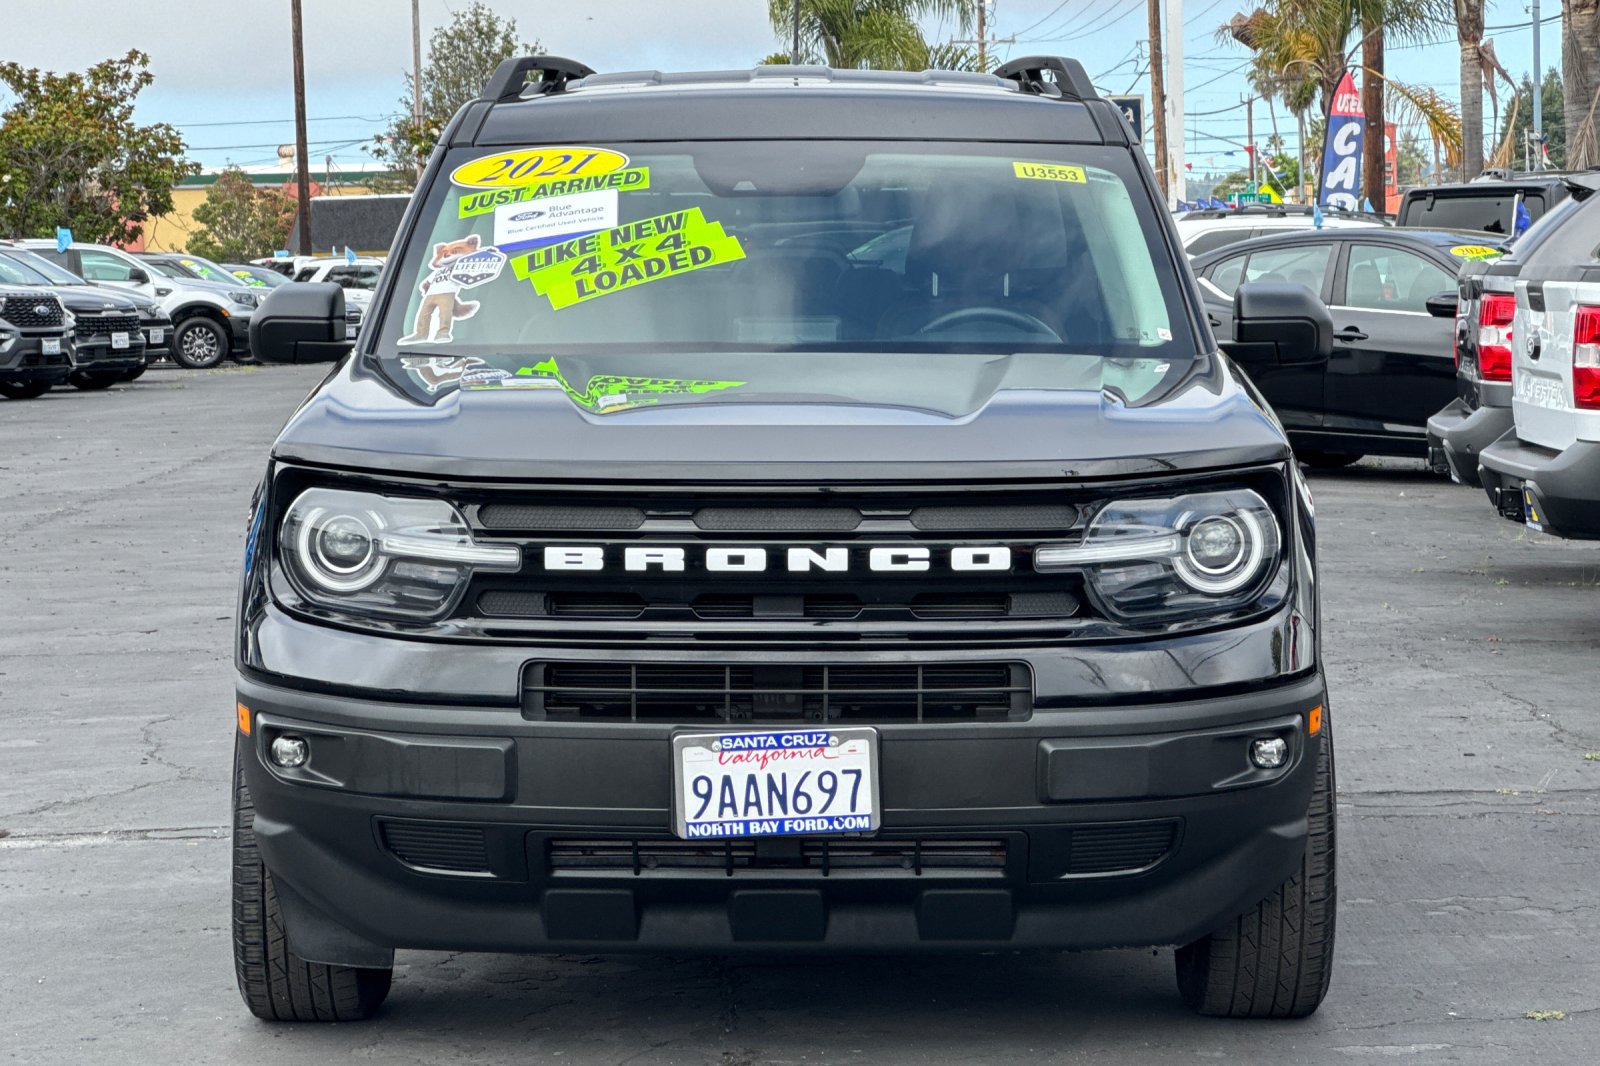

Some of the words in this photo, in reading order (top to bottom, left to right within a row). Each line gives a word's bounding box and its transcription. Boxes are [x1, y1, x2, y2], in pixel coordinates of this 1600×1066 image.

[476, 153, 600, 184] 2021
[1023, 166, 1079, 181] U3553
[463, 187, 531, 212] JUST
[531, 170, 641, 199] ARRIVED
[548, 205, 605, 218] Advantage
[549, 204, 572, 213] Blue
[525, 222, 556, 232] Certified
[578, 215, 605, 223] Vehicle
[528, 234, 600, 273] LIKE
[610, 212, 689, 247] NEW
[571, 255, 606, 276] 4
[656, 232, 691, 252] 4
[455, 262, 498, 270] LIFETIME
[575, 245, 714, 298] LOADED
[544, 547, 1011, 571] BRONCO
[722, 736, 775, 750] SANTA
[781, 733, 828, 747] CRUZ
[718, 747, 840, 770] California
[692, 768, 863, 819] 9AAN697
[688, 821, 745, 837] NORTH
[750, 820, 780, 834] BAY
[784, 816, 869, 832] FORD.COM
